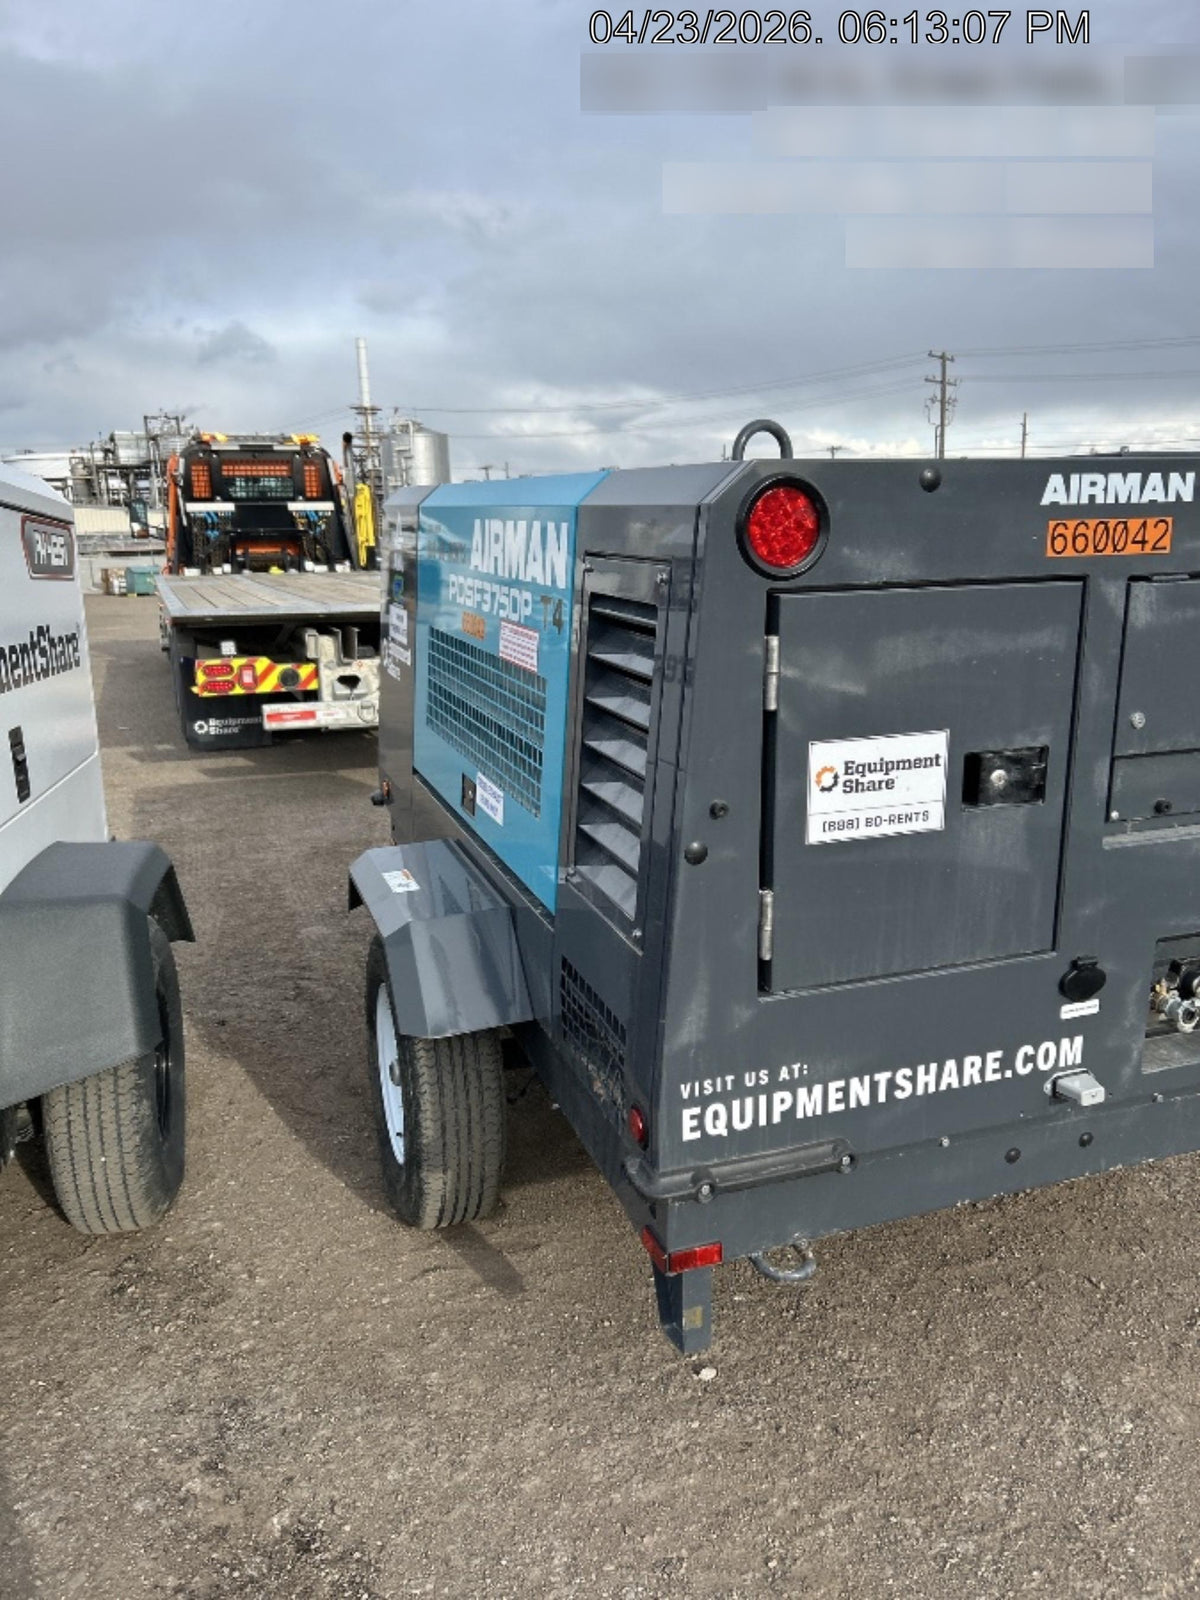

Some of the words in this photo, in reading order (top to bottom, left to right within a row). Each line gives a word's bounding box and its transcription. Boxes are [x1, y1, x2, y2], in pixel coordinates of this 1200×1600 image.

[1040, 472, 1196, 505] AIRMAN
[469, 518, 568, 589] AIRMAN
[1050, 518, 1169, 555] 660042
[843, 753, 942, 777] Equipment
[842, 778, 896, 794] Share
[680, 1074, 735, 1099] VISIT
[744, 1068, 770, 1087] US
[778, 1063, 809, 1081] AT:
[681, 1035, 1084, 1141] EQUIPMENTSHARE.COM
